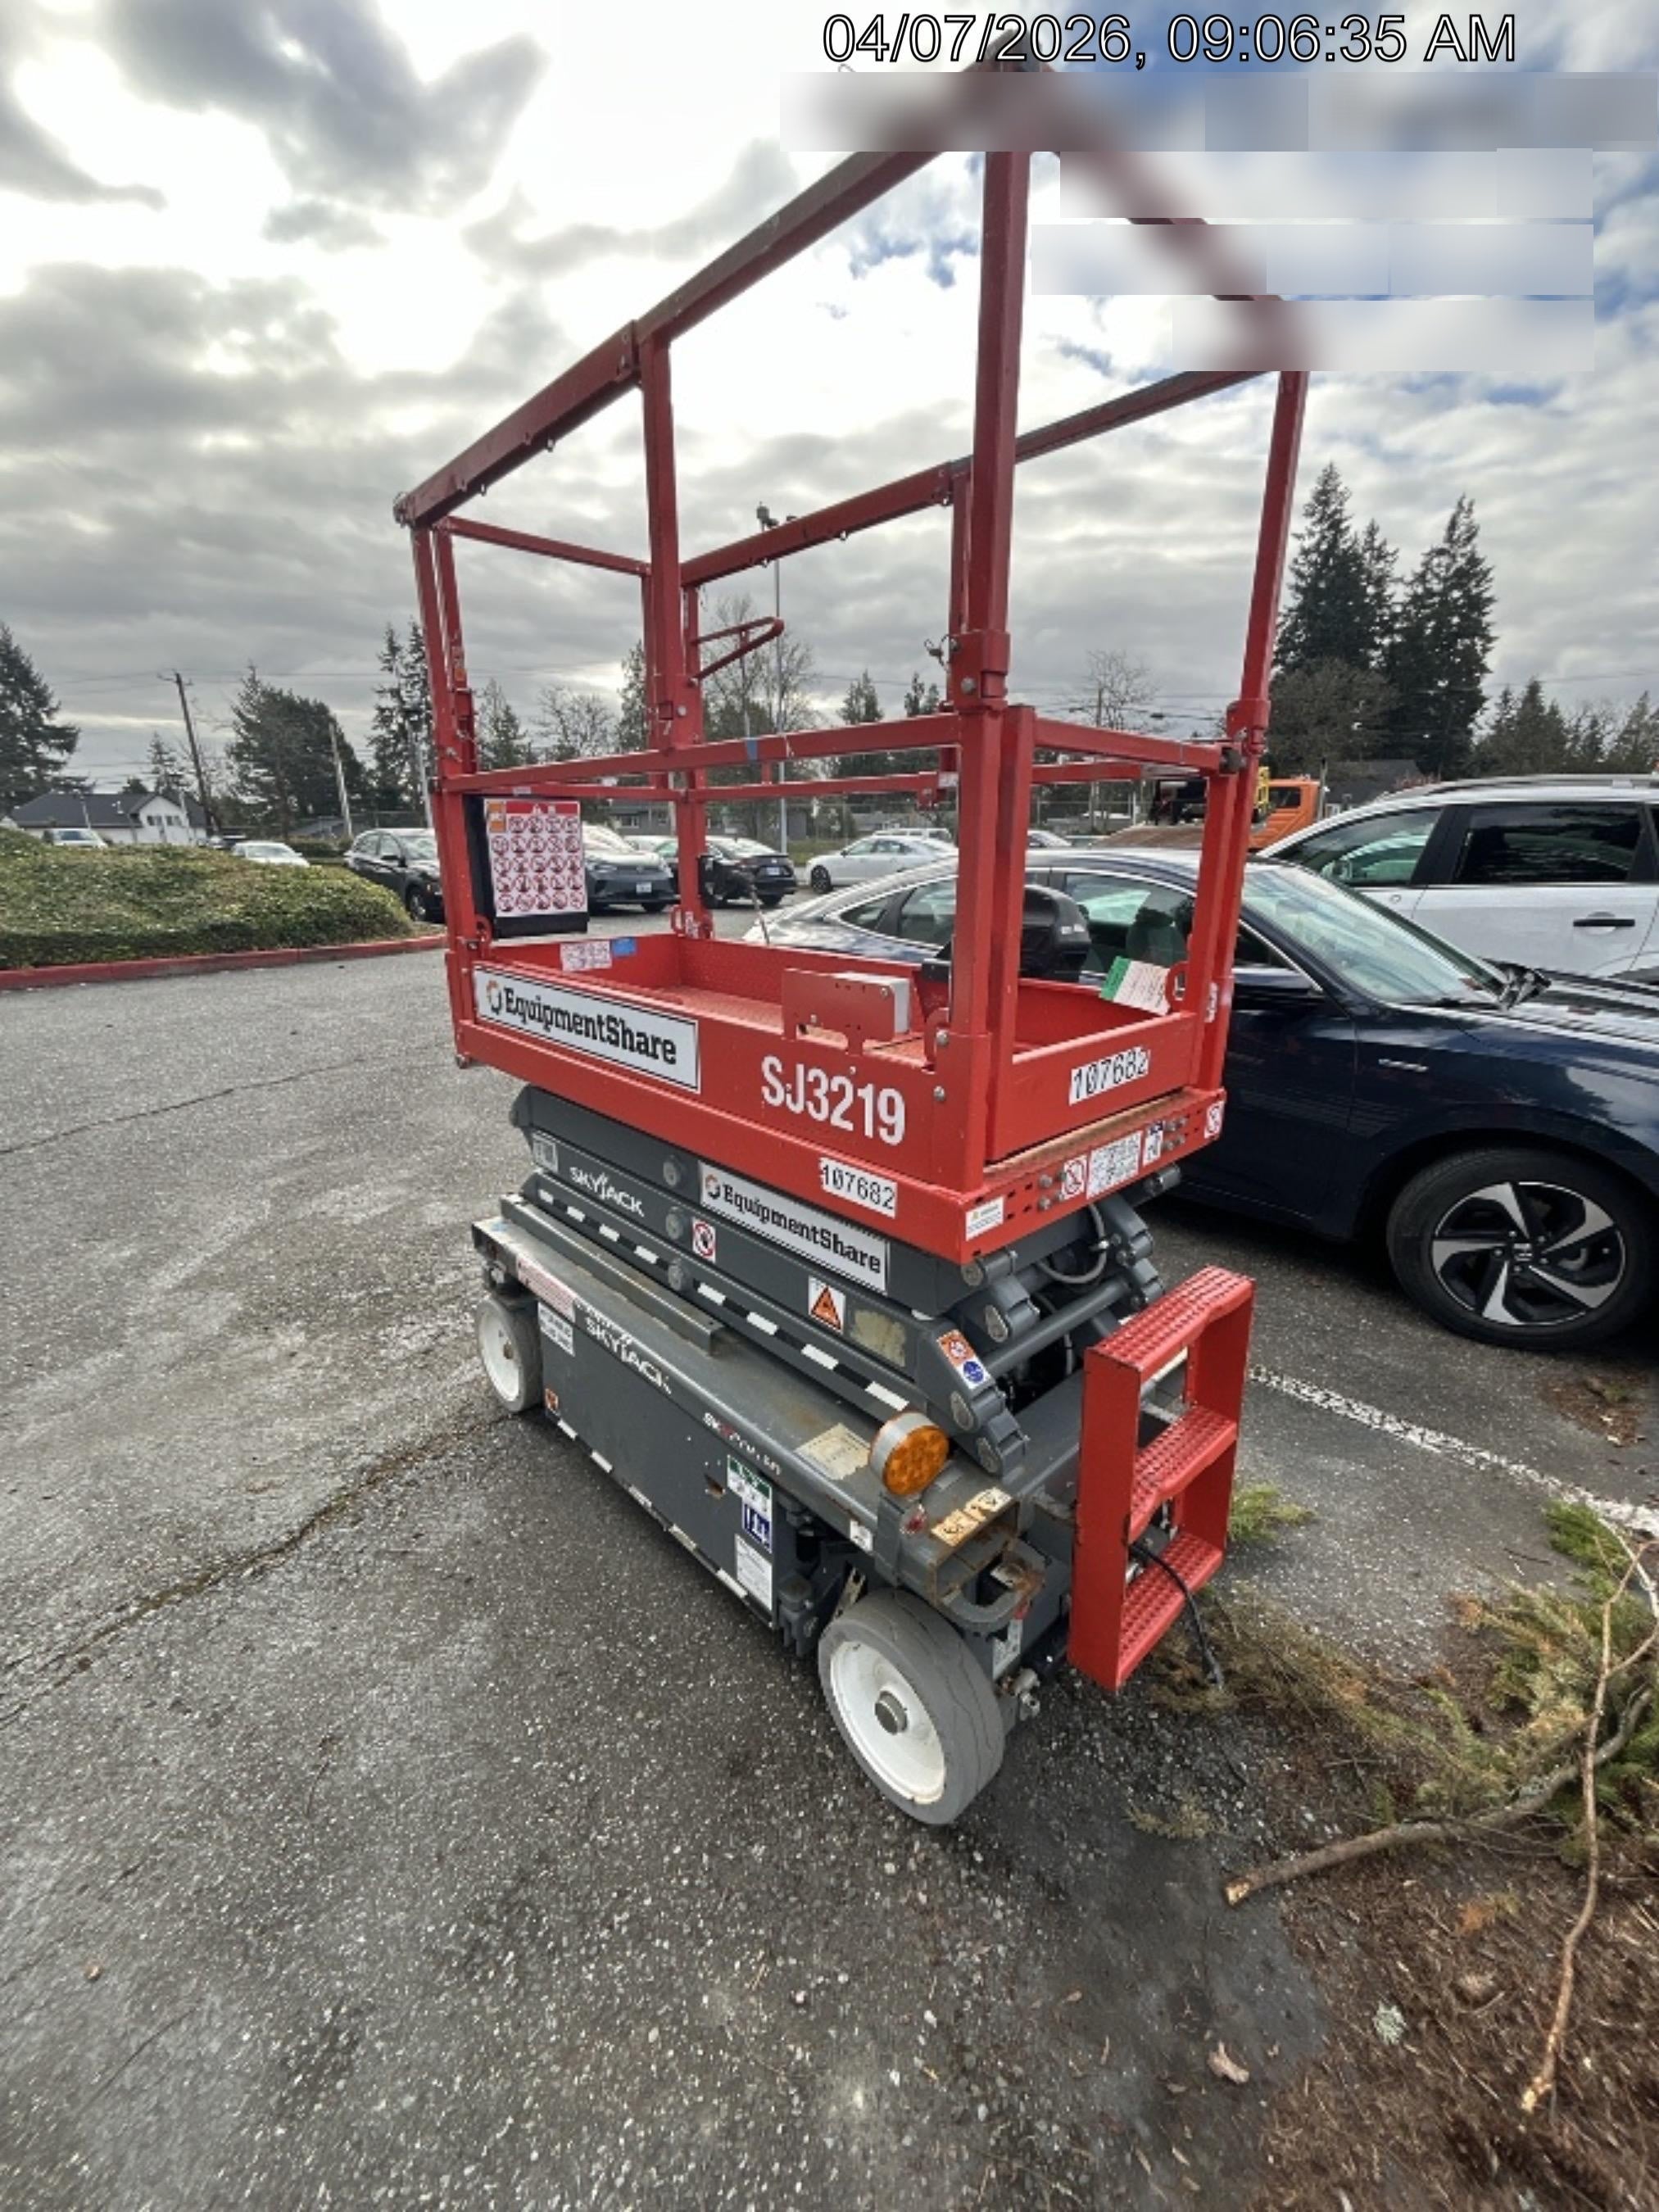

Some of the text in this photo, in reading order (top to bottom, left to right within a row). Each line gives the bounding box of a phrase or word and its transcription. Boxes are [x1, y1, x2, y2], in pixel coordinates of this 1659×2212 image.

[504, 987, 677, 1064] EquipmentShare
[761, 1055, 906, 1145] SJ3219
[1074, 1047, 1150, 1099] 107682
[569, 1166, 645, 1217] SKYJACK
[822, 1163, 895, 1210] 107682
[723, 1184, 881, 1274] EquipmentShare
